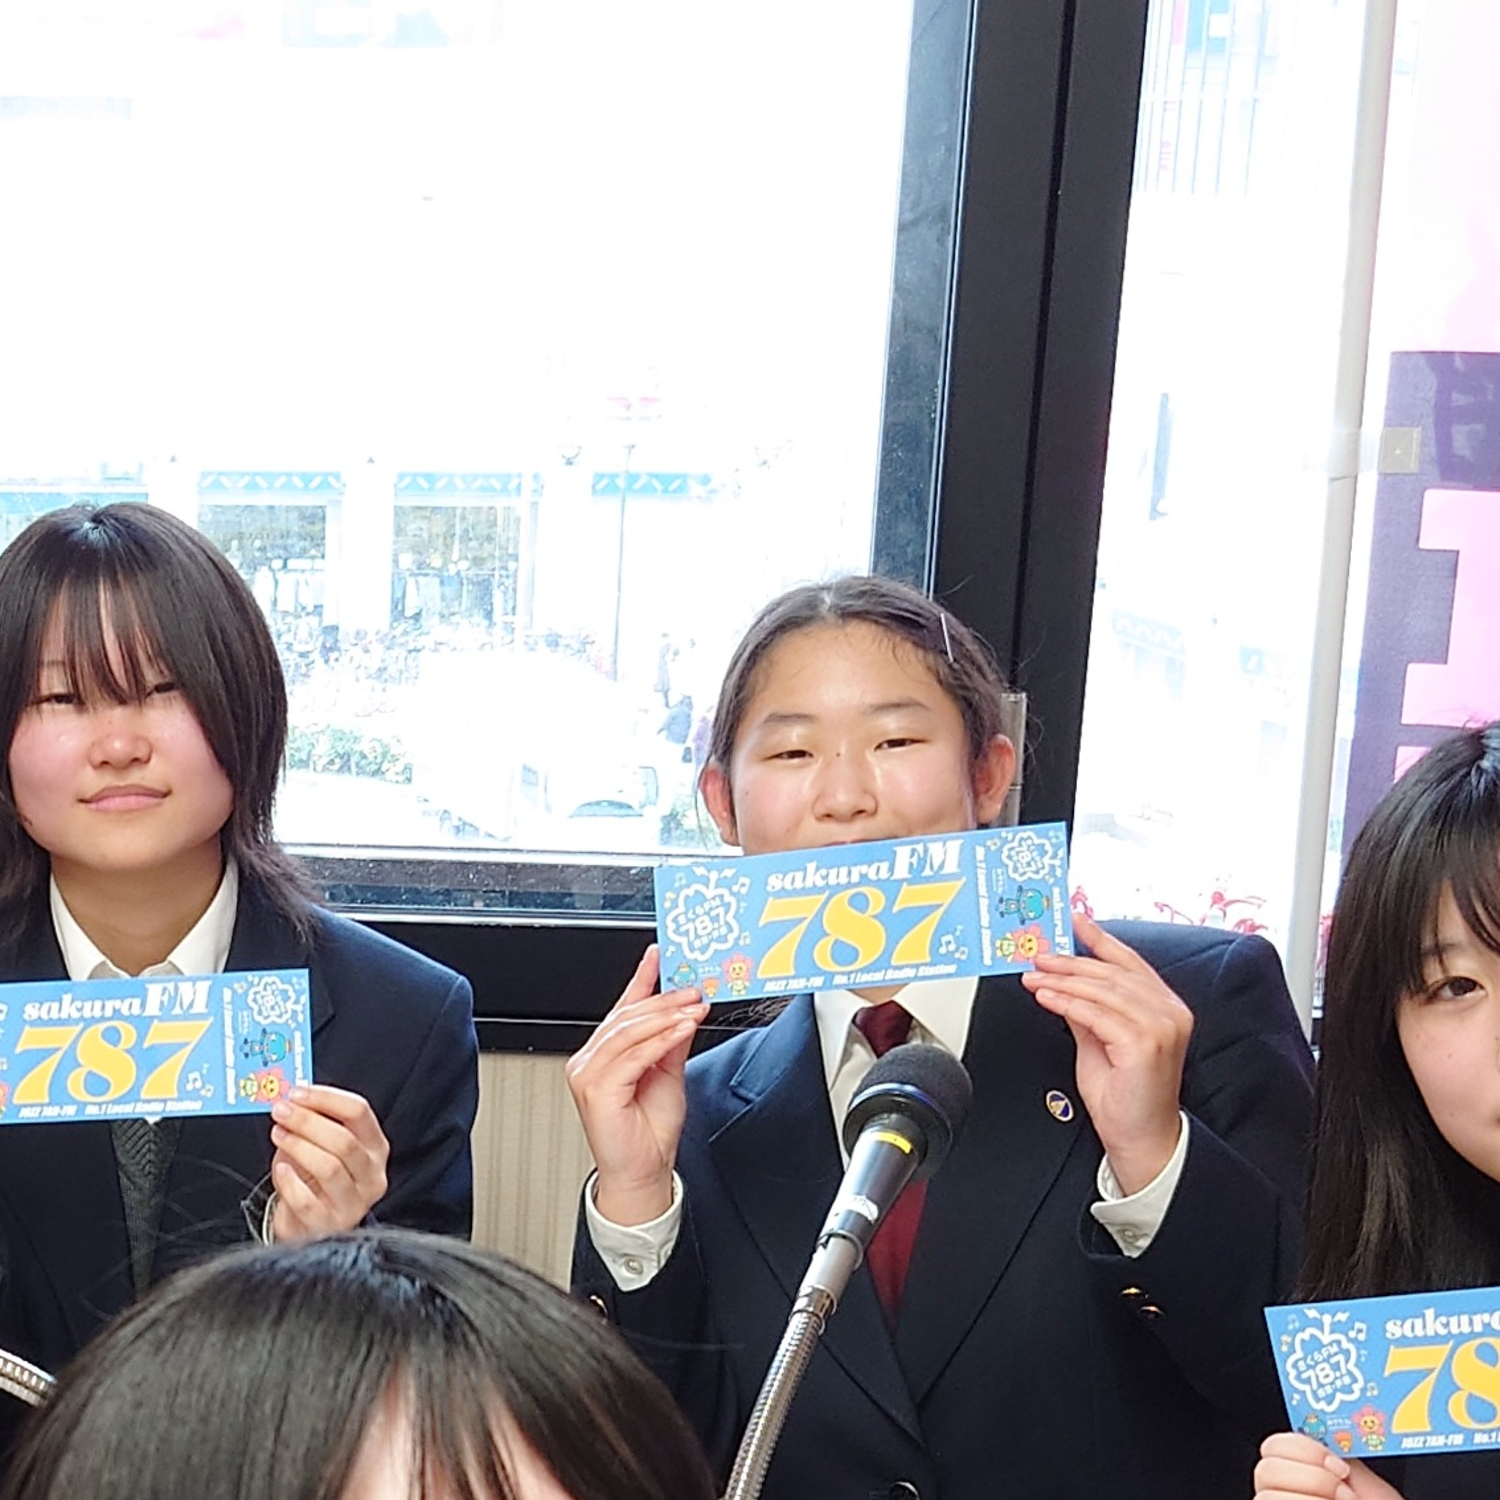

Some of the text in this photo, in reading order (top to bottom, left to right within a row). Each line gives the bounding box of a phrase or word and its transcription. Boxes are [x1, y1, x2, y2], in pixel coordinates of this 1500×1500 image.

[765, 839, 963, 892] sakuraFM
[679, 906, 723, 939] 78.7
[758, 877, 966, 977] 787
[23, 980, 212, 1020] sakuraFM
[12, 1017, 214, 1103] 787
[1300, 1353, 1345, 1389] 78.7
[1383, 1337, 1500, 1434] 78
